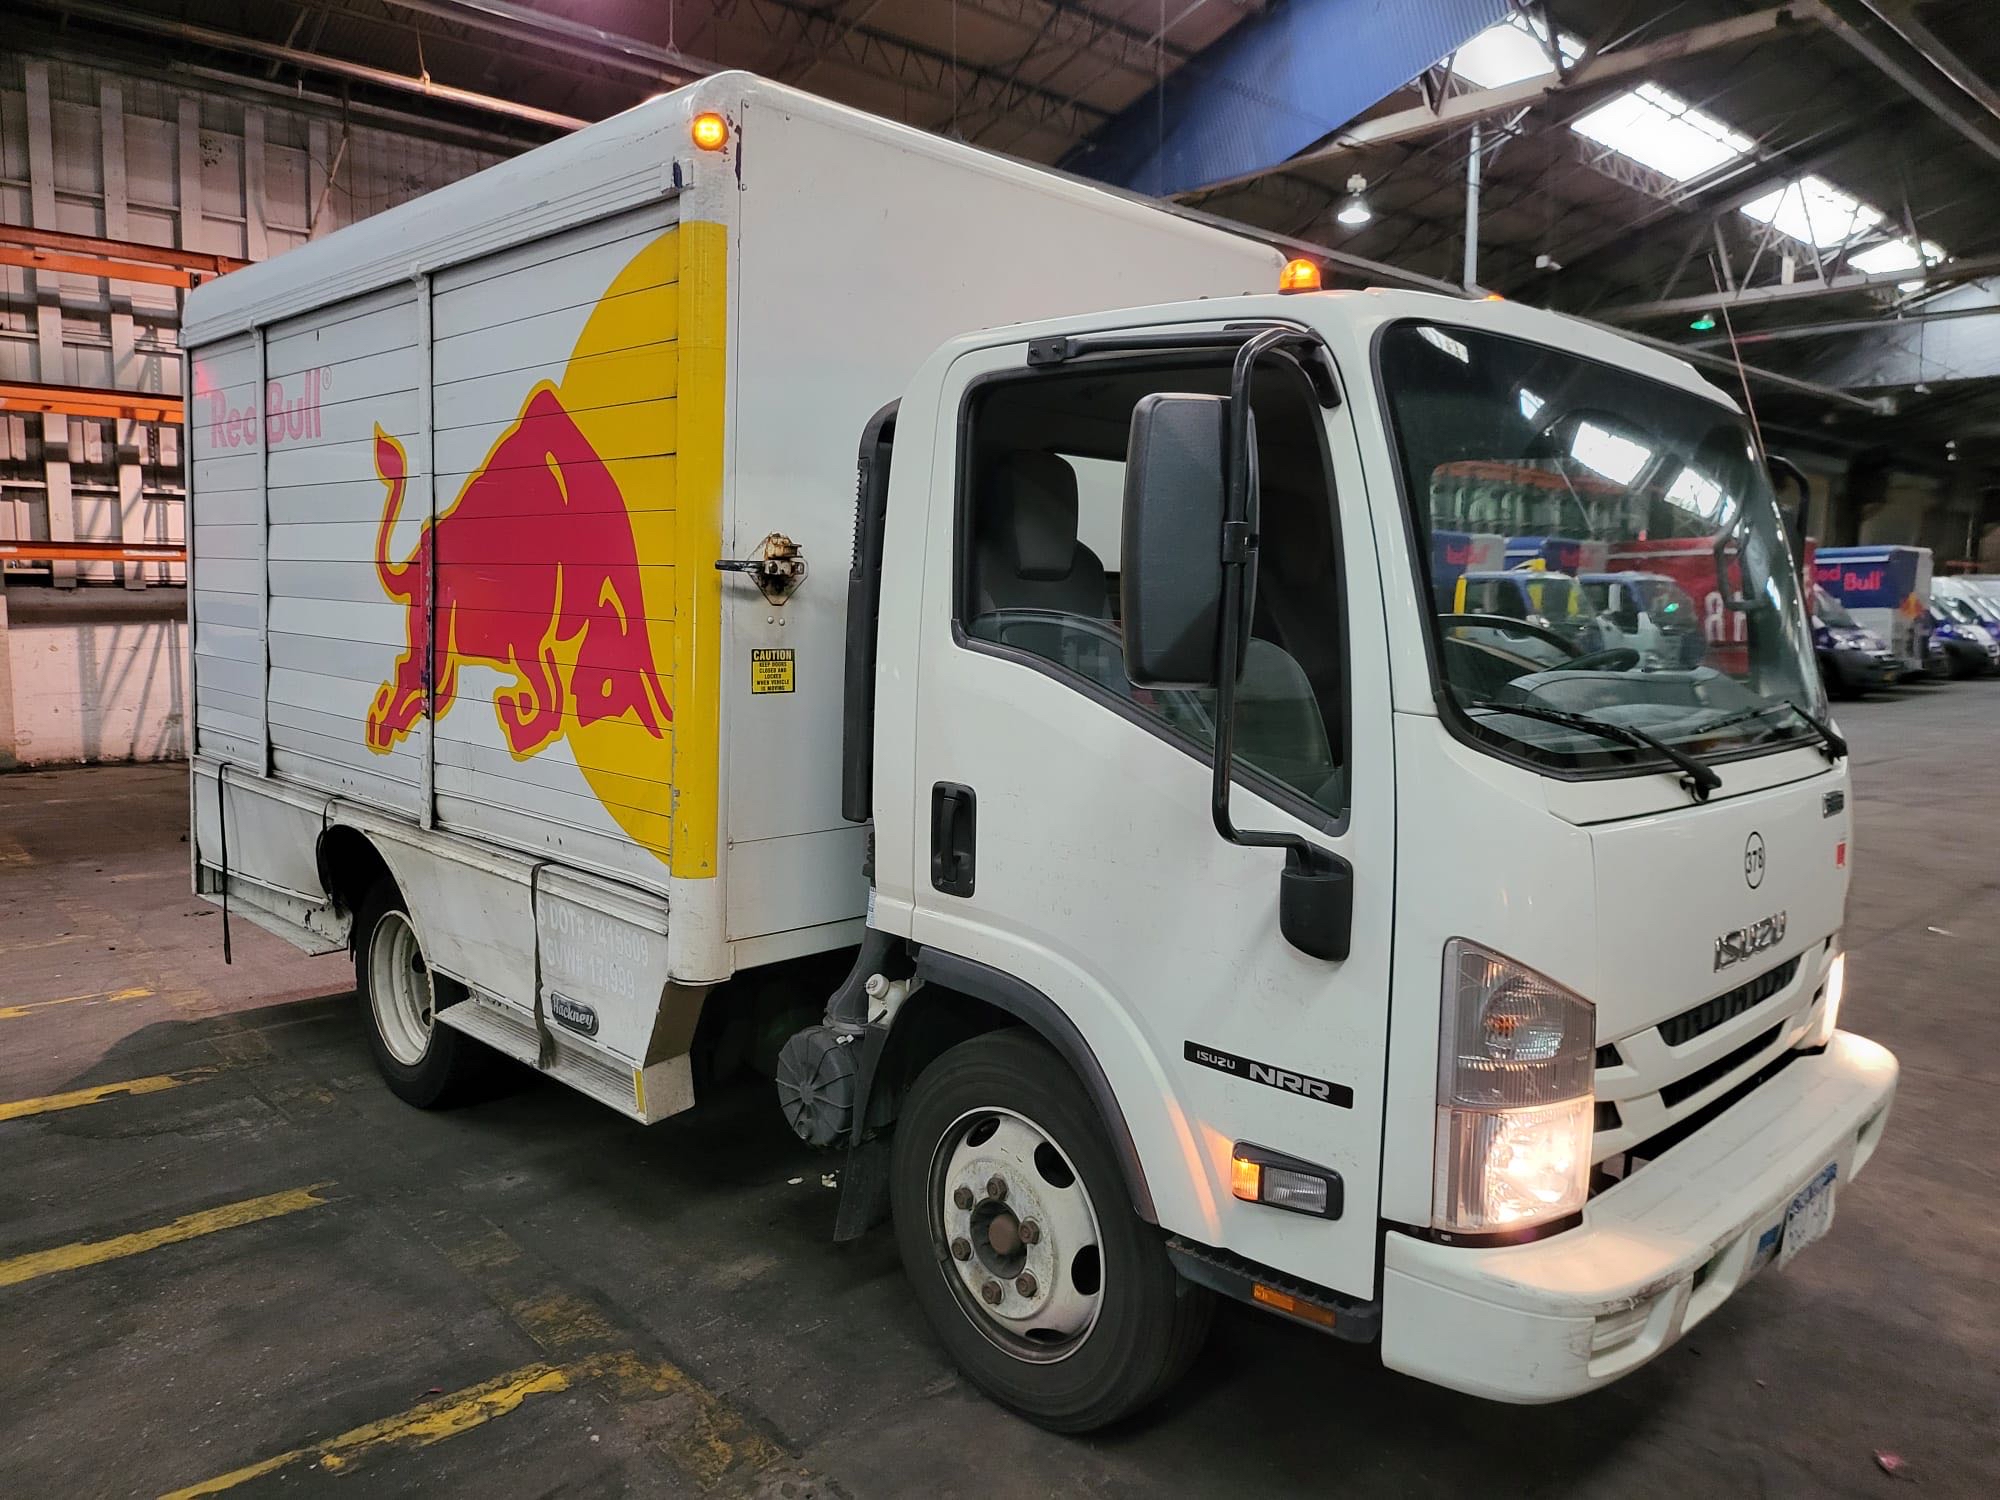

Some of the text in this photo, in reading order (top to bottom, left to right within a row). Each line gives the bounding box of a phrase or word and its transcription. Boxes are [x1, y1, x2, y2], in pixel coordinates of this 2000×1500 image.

[210, 383, 257, 448] Red
[753, 650, 792, 661] CAUTION
[549, 902, 585, 940] DOT#
[1713, 909, 1786, 973] ISUZU
[552, 997, 594, 1030] Hackney
[1196, 1049, 1330, 1101] ISUZU NRR
